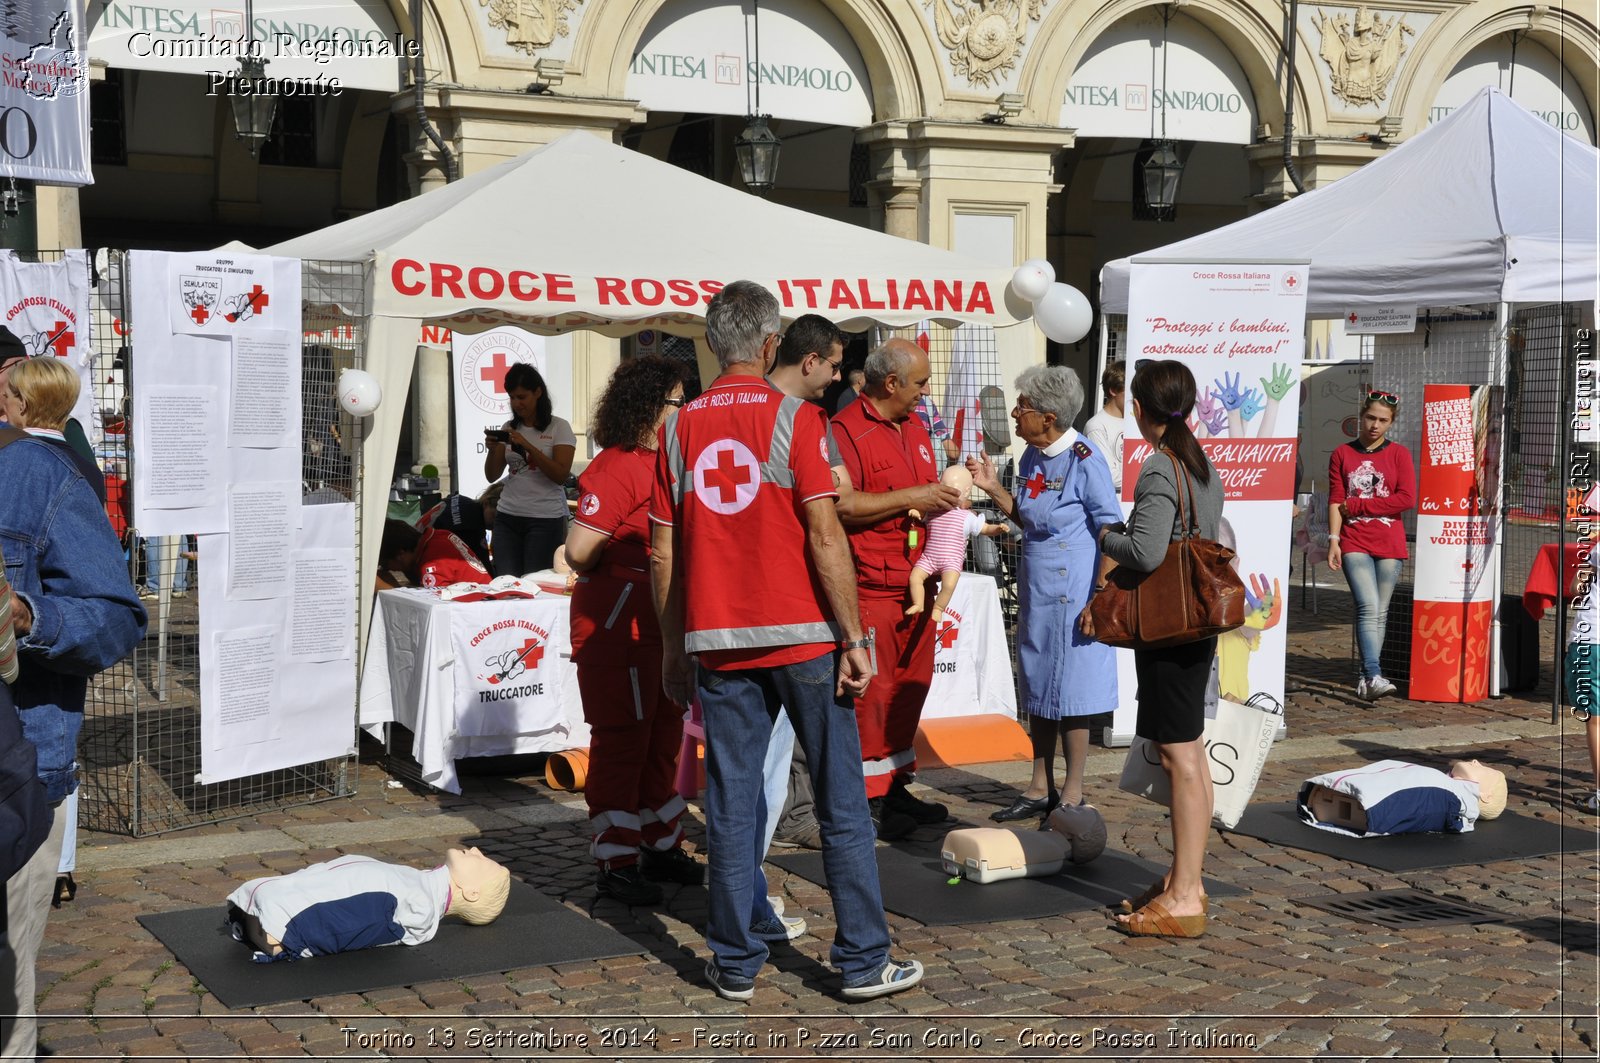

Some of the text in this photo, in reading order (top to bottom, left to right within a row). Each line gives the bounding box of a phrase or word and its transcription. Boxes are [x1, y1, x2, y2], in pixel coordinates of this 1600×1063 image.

[102, 2, 202, 36] INTESA
[2, 52, 78, 77] Seembre
[632, 53, 852, 92] INTESA SANPAOLO
[2, 70, 51, 93] Muica
[1062, 85, 1242, 114] NTESA SANPAOLO
[227, 267, 254, 275] SIMULATORI
[1193, 271, 1271, 280] Croce Rossa Italiana
[184, 280, 219, 289] SIMULATORI
[391, 258, 995, 314] CROCE ROSS ITALIANA
[1142, 343, 1209, 355] costruisci
[1213, 340, 1227, 354] il
[687, 392, 768, 412] CROCE ROSSA ITALIANA
[1425, 398, 1470, 408] ASCOLTARE
[1426, 403, 1471, 415] AMARE
[1426, 411, 1471, 421] CREDERE
[1427, 417, 1472, 431] DARE
[1427, 427, 1473, 437] RICEVERE
[1428, 433, 1473, 443] GIOCARE
[1208, 443, 1294, 463] SALVAVITA
[1428, 440, 1474, 451] VOLARE
[1430, 451, 1475, 466] FARE
[1461, 461, 1475, 472] di
[470, 619, 549, 647] CROCE ROSSA ITALIANA
[479, 683, 544, 703] TRUCCATORE
